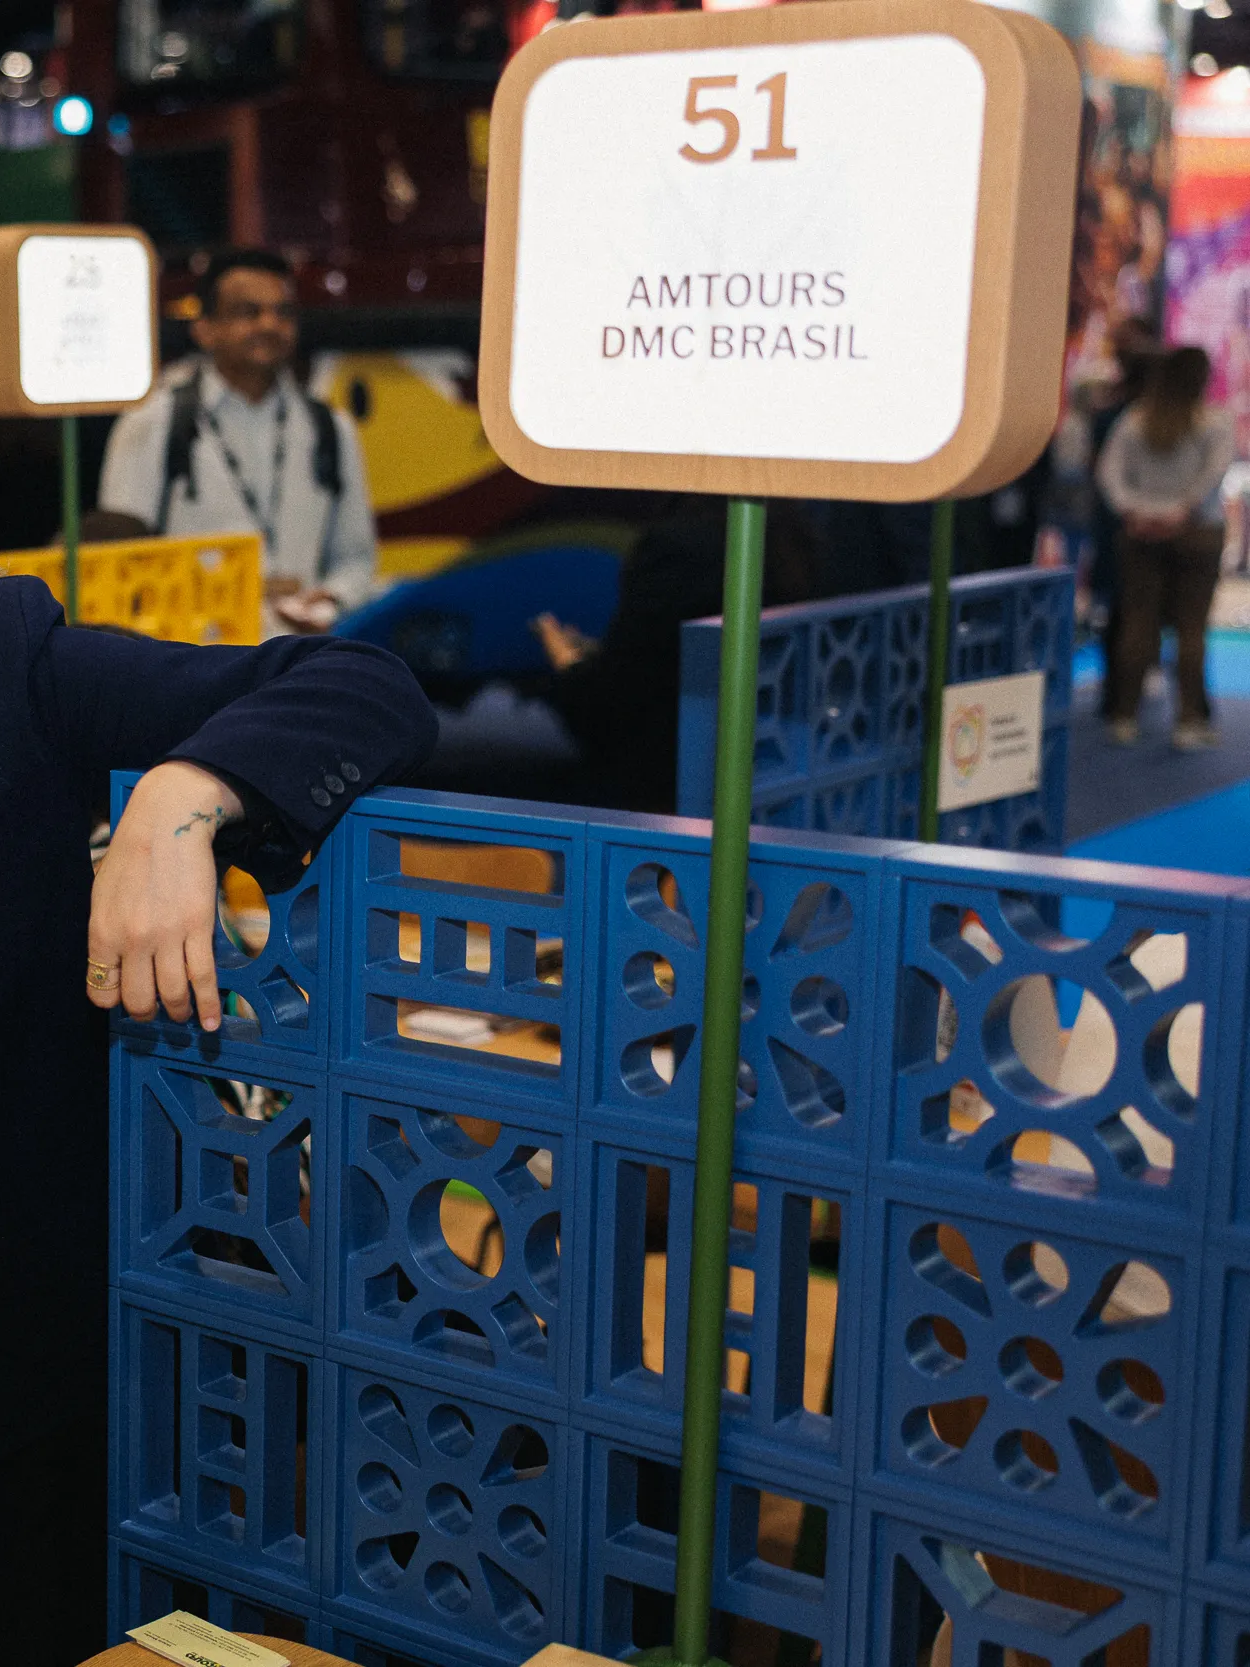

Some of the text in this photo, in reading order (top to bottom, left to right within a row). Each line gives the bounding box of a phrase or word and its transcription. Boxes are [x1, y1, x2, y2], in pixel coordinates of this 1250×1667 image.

[677, 71, 799, 165] 51
[626, 270, 847, 309] AMTOURS
[600, 323, 870, 361] DMC BRASIL
